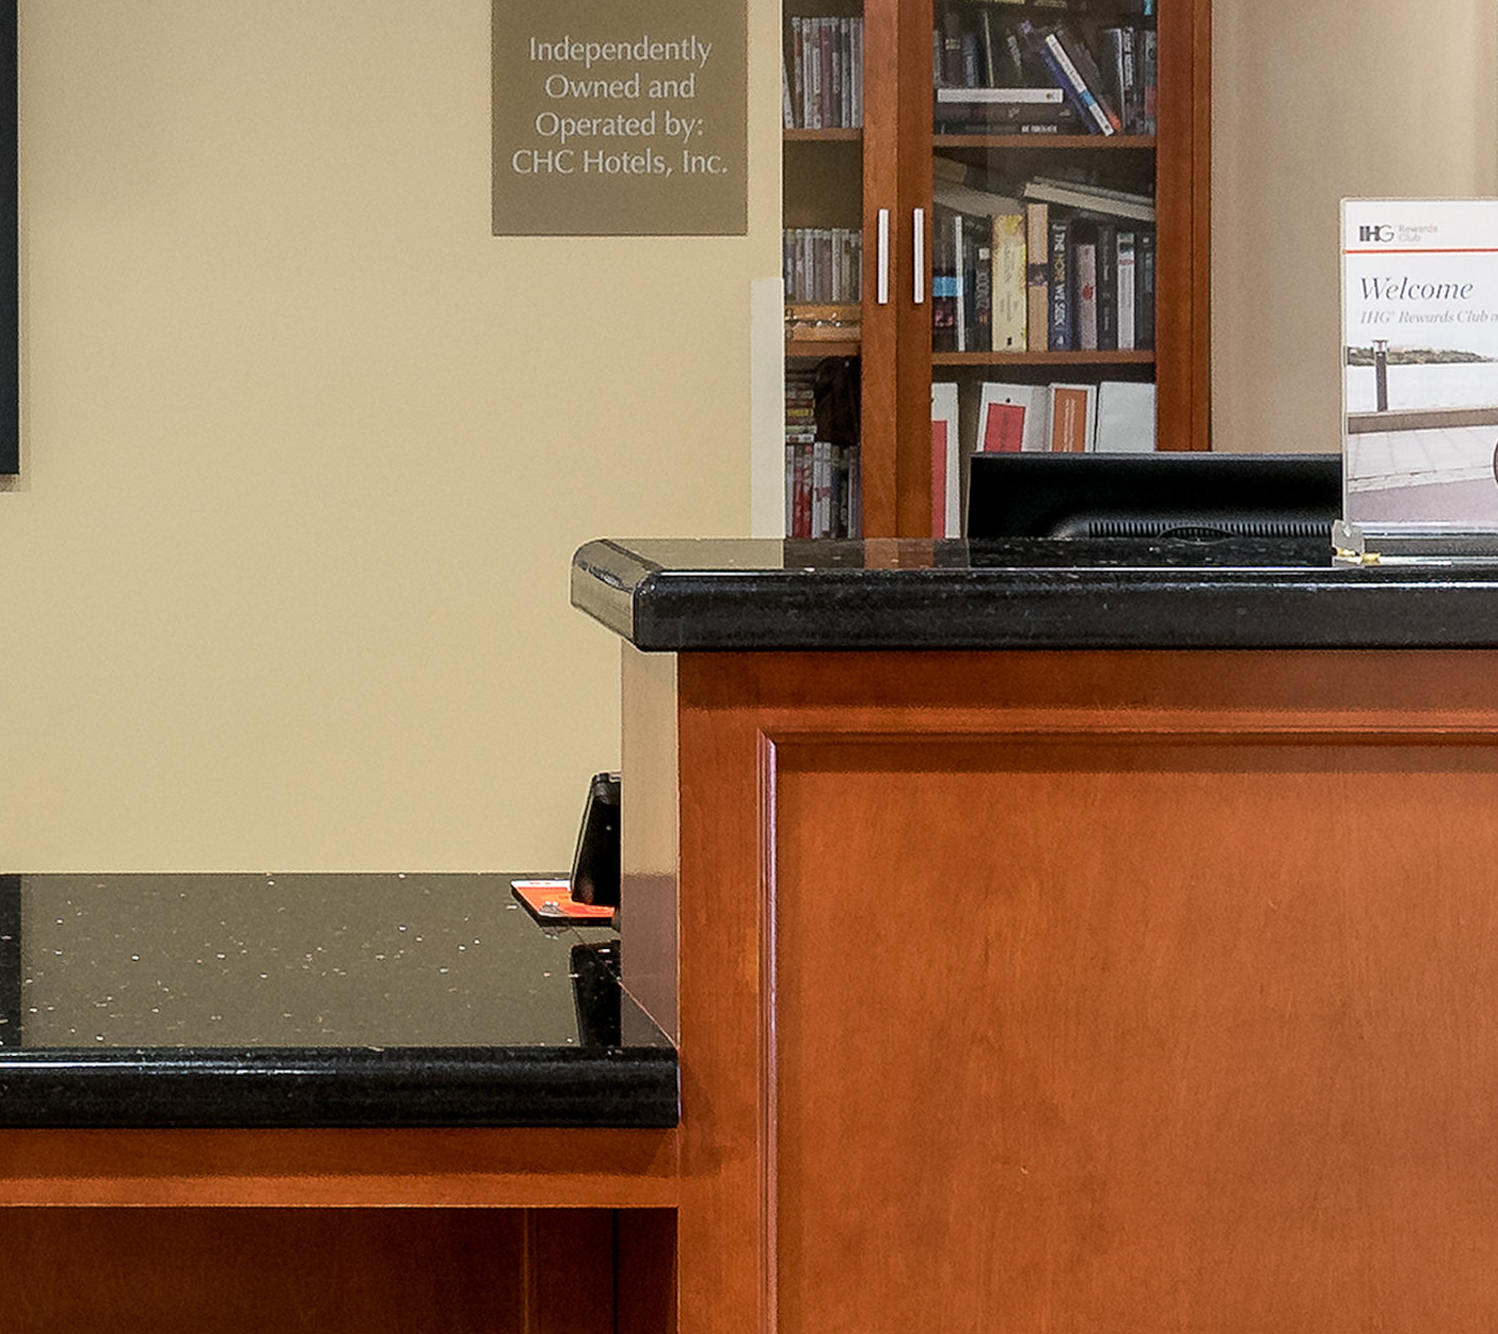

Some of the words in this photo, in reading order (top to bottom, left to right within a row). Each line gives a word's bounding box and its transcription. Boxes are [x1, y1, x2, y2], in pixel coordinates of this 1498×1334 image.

[529, 35, 712, 68] Independently
[545, 72, 640, 99] Owned
[648, 72, 695, 99] and
[535, 110, 655, 144] Operated
[665, 110, 704, 144] by:
[512, 149, 574, 174] CHC
[583, 148, 673, 178] Hotels,
[682, 150, 728, 174] Inc.
[1359, 224, 1395, 242] IHG
[1398, 224, 1438, 233] Rewards
[1398, 233, 1421, 242] Club
[1360, 276, 1474, 300] Welcome
[1398, 310, 1453, 324] Rewards
[1457, 310, 1488, 324] Club
